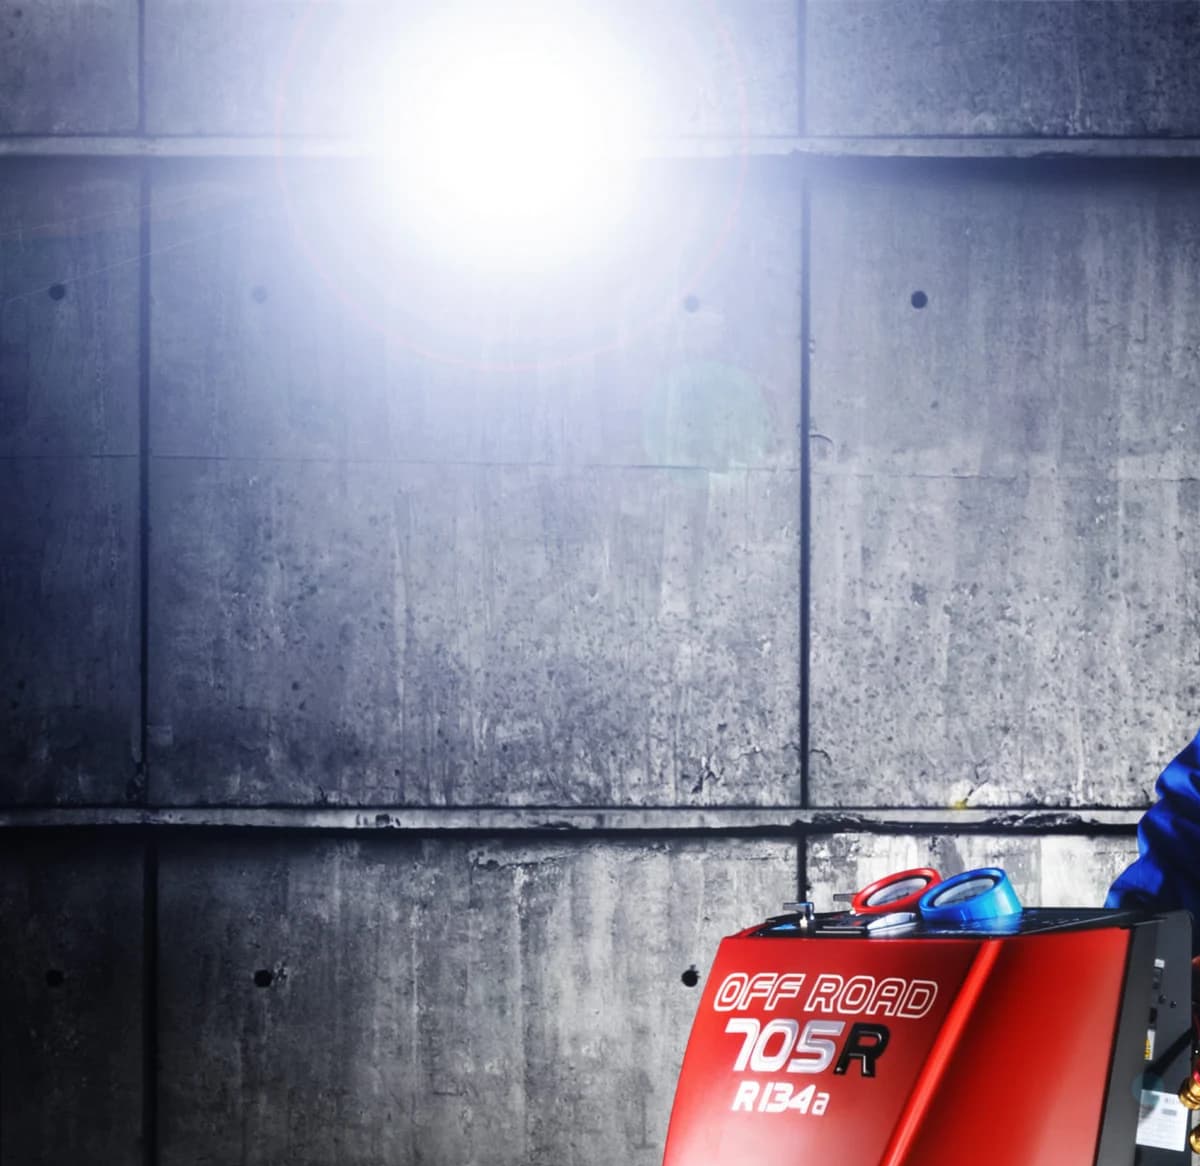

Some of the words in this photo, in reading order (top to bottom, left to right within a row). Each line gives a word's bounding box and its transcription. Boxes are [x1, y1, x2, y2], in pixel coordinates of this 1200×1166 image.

[713, 972, 806, 1012] OFF
[804, 973, 939, 1019] ROAD
[724, 1017, 891, 1078] 705R
